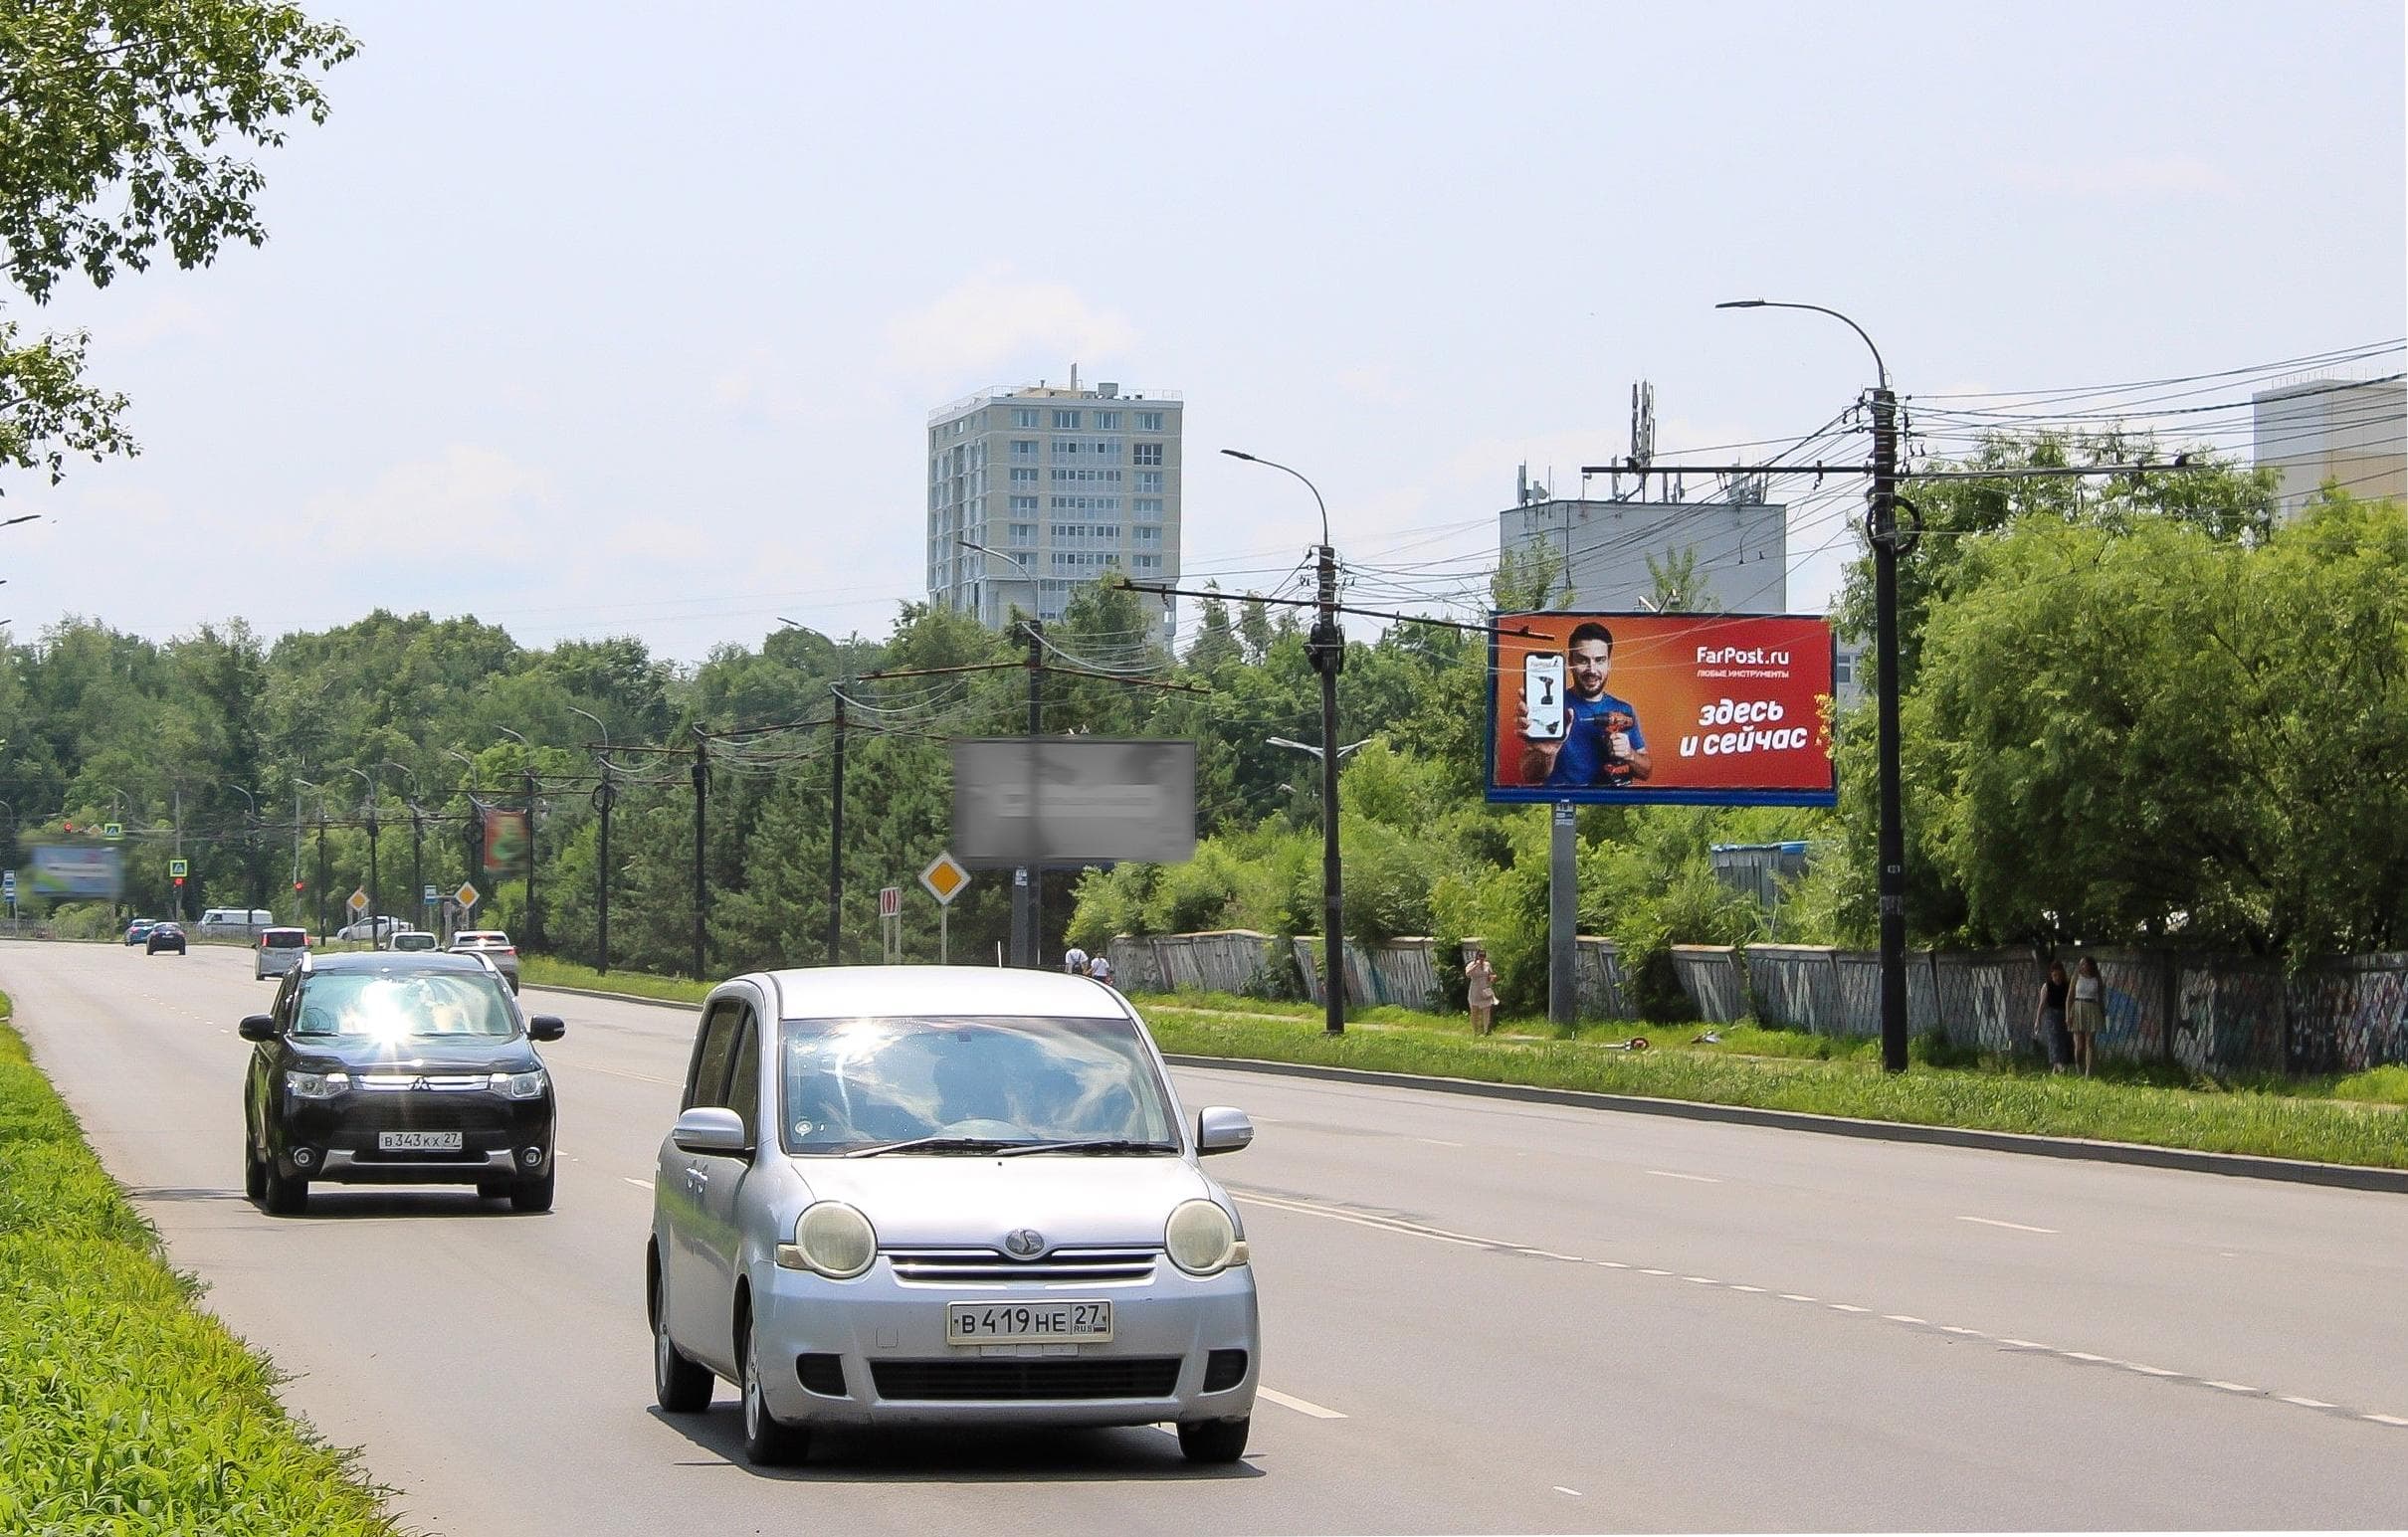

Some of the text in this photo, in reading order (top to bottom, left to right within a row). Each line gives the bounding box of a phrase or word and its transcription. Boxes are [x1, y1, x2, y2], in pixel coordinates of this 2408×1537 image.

[1697, 646, 1789, 665] FarPost.ru
[1698, 698, 1784, 726] здесь
[1680, 725, 1808, 757] и сейчас
[1075, 1305, 1100, 1324] 27
[1074, 1324, 1093, 1333] RUS
